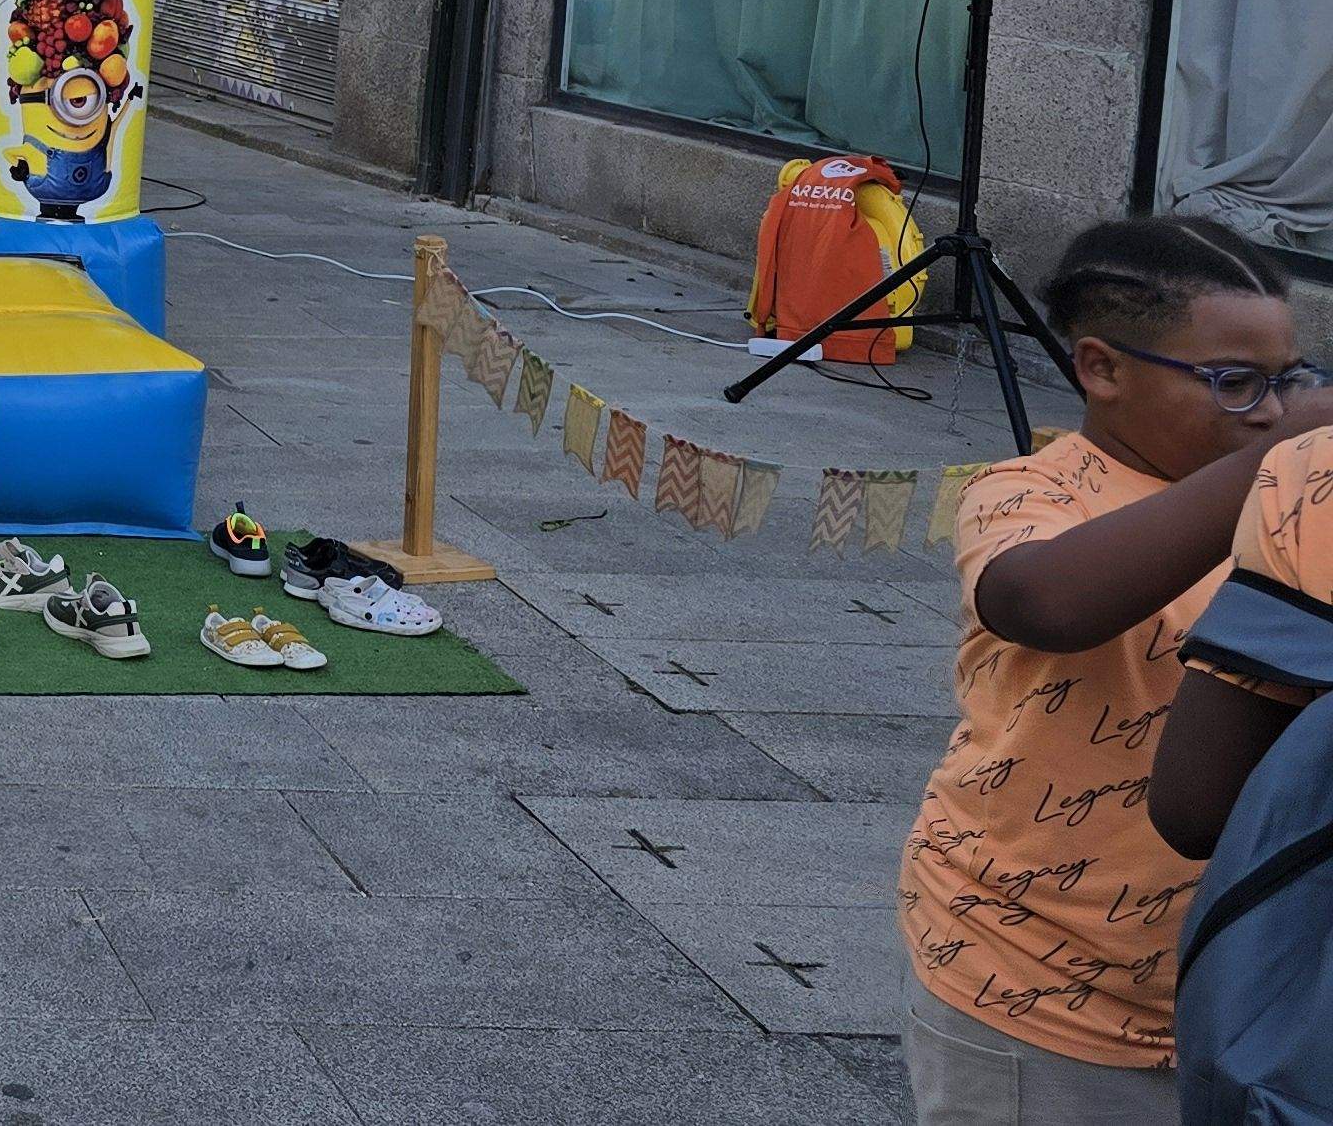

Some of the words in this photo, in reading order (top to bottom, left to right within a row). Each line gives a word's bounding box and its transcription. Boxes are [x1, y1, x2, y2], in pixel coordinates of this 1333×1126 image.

[791, 184, 855, 204] AREXAD
[1090, 704, 1173, 749] Lega
[1034, 782, 1151, 826] Legacy
[1106, 878, 1199, 925] Lega
[974, 973, 1098, 1017] Legacy
